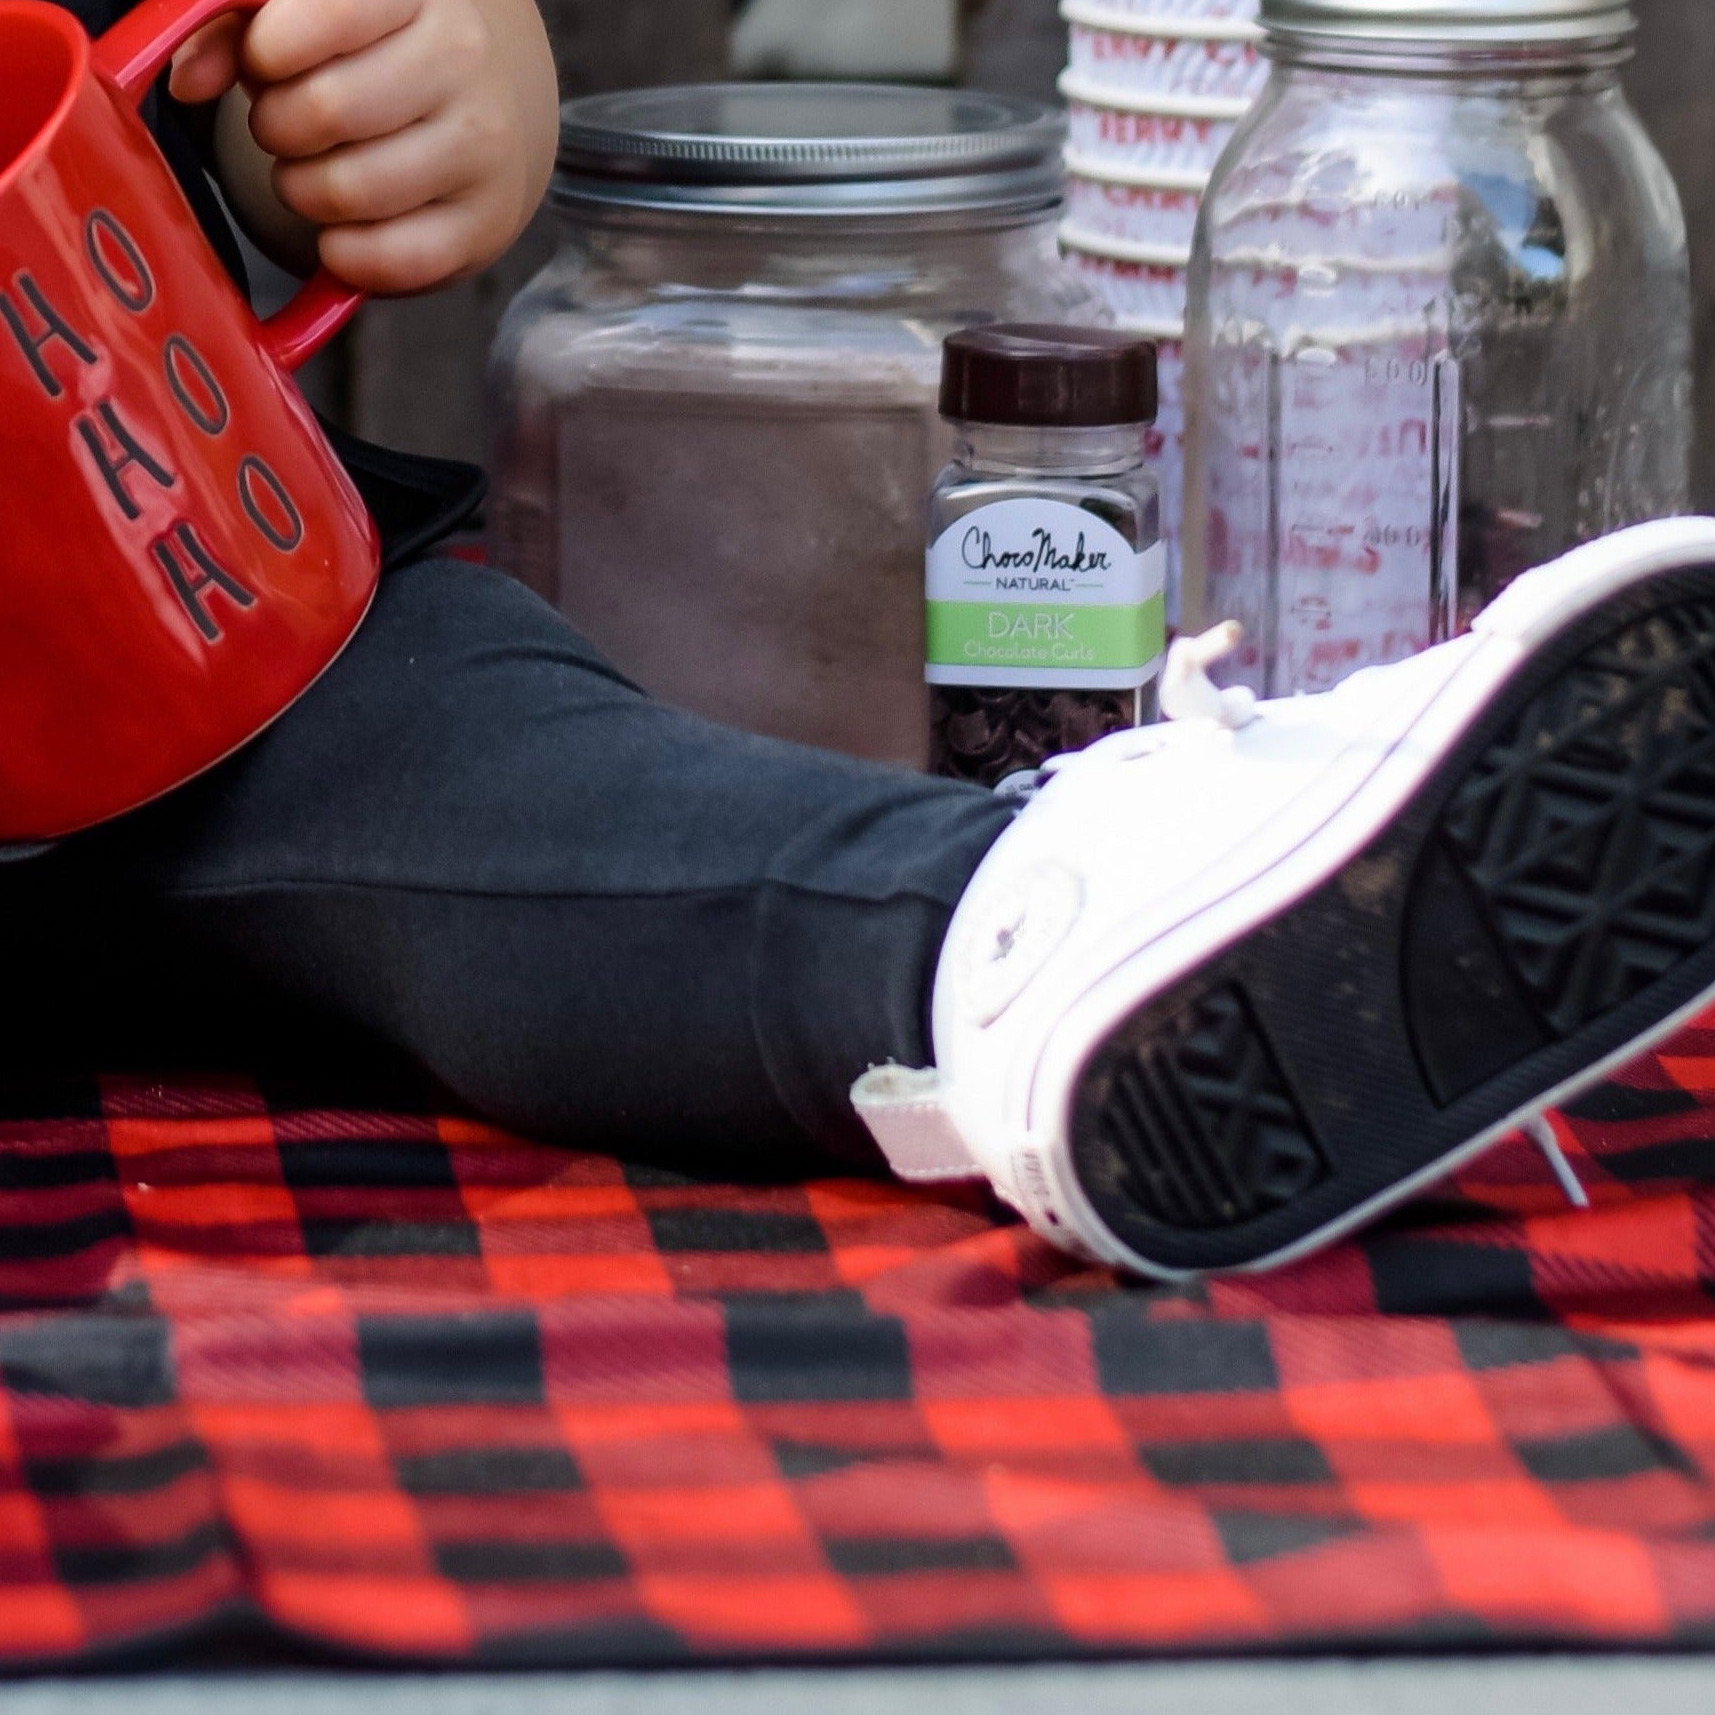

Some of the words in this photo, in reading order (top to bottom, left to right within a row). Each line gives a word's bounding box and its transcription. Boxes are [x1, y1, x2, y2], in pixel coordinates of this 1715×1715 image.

[73, 332, 229, 522] HO
[152, 454, 305, 643] HO
[964, 640, 1049, 660] Chocolate
[1051, 642, 1094, 662] Curls
[988, 611, 1075, 640] DARK
